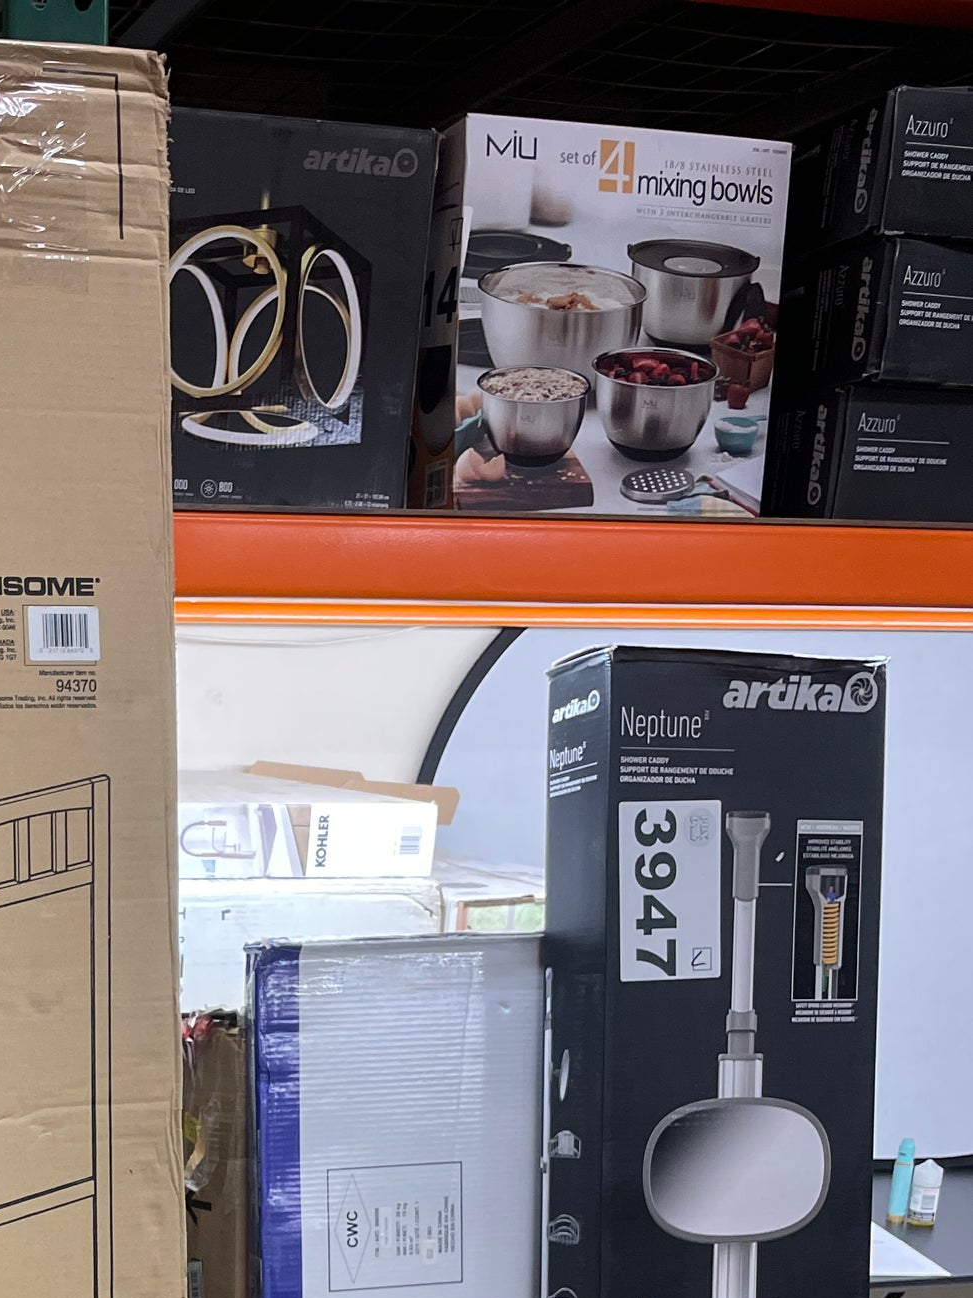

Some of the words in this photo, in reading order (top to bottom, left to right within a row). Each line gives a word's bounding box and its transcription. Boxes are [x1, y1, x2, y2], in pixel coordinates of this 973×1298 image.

[905, 114, 949, 139] Azzuro
[856, 107, 878, 190] artika
[904, 150, 929, 159] SHOWER
[929, 152, 950, 161] CADDY
[303, 148, 392, 177] artika
[688, 161, 742, 176] STAINLESS
[744, 166, 774, 179] STEEL
[902, 159, 931, 170] SUPPORT
[930, 161, 940, 170] DE
[559, 150, 581, 165] set
[582, 150, 597, 165] of
[599, 139, 636, 194] 4
[637, 172, 707, 207] mixing
[710, 174, 774, 206] bowls
[901, 169, 943, 180] ORGANIZADOR
[942, 172, 951, 180] DE
[950, 173, 972, 182] DUCHA
[902, 265, 942, 288] Azzuro
[854, 256, 874, 337] artika
[901, 299, 924, 309] SHOWER
[924, 301, 942, 310] CADDY
[898, 318, 936, 328] ORGANIZADOR
[935, 321, 943, 329] DE
[942, 322, 961, 330] DUCHA
[899, 309, 925, 318] SUPPORT
[924, 311, 933, 319] DE
[933, 312, 963, 321] RANGEMENT
[857, 412, 896, 434] Azzuro
[810, 404, 828, 481] artika
[856, 445, 878, 454] SHOWER
[878, 447, 896, 455] CADDY
[853, 463, 890, 472] ORGANIZADOR
[889, 465, 898, 473] DE
[896, 465, 916, 474] DUCHA
[854, 454, 878, 463] SUPPORT
[879, 455, 887, 463] DE
[887, 456, 918, 465] RANGEMENT
[918, 457, 927, 465] DE
[926, 458, 948, 466] DOUCHE
[218, 481, 233, 494] 800
[55, 678, 97, 693] 94370
[722, 674, 843, 712] artika
[552, 696, 589, 724] artika
[620, 706, 703, 744] Neptune
[549, 745, 583, 771] Neptune
[620, 755, 648, 765] SHOWER
[648, 756, 670, 765] CADDY
[619, 765, 650, 775] SUPPORT
[650, 766, 659, 775] DE
[659, 766, 699, 776] RANGEMENT
[699, 767, 708, 776] DE
[708, 767, 734, 777] DOUCHE
[619, 775, 664, 785] ORGANIZADOR
[664, 776, 674, 785] DE
[674, 776, 697, 785] DUCHA
[314, 814, 331, 868] KOHLER
[633, 808, 678, 977] 3947
[346, 1210, 359, 1248] CWC
